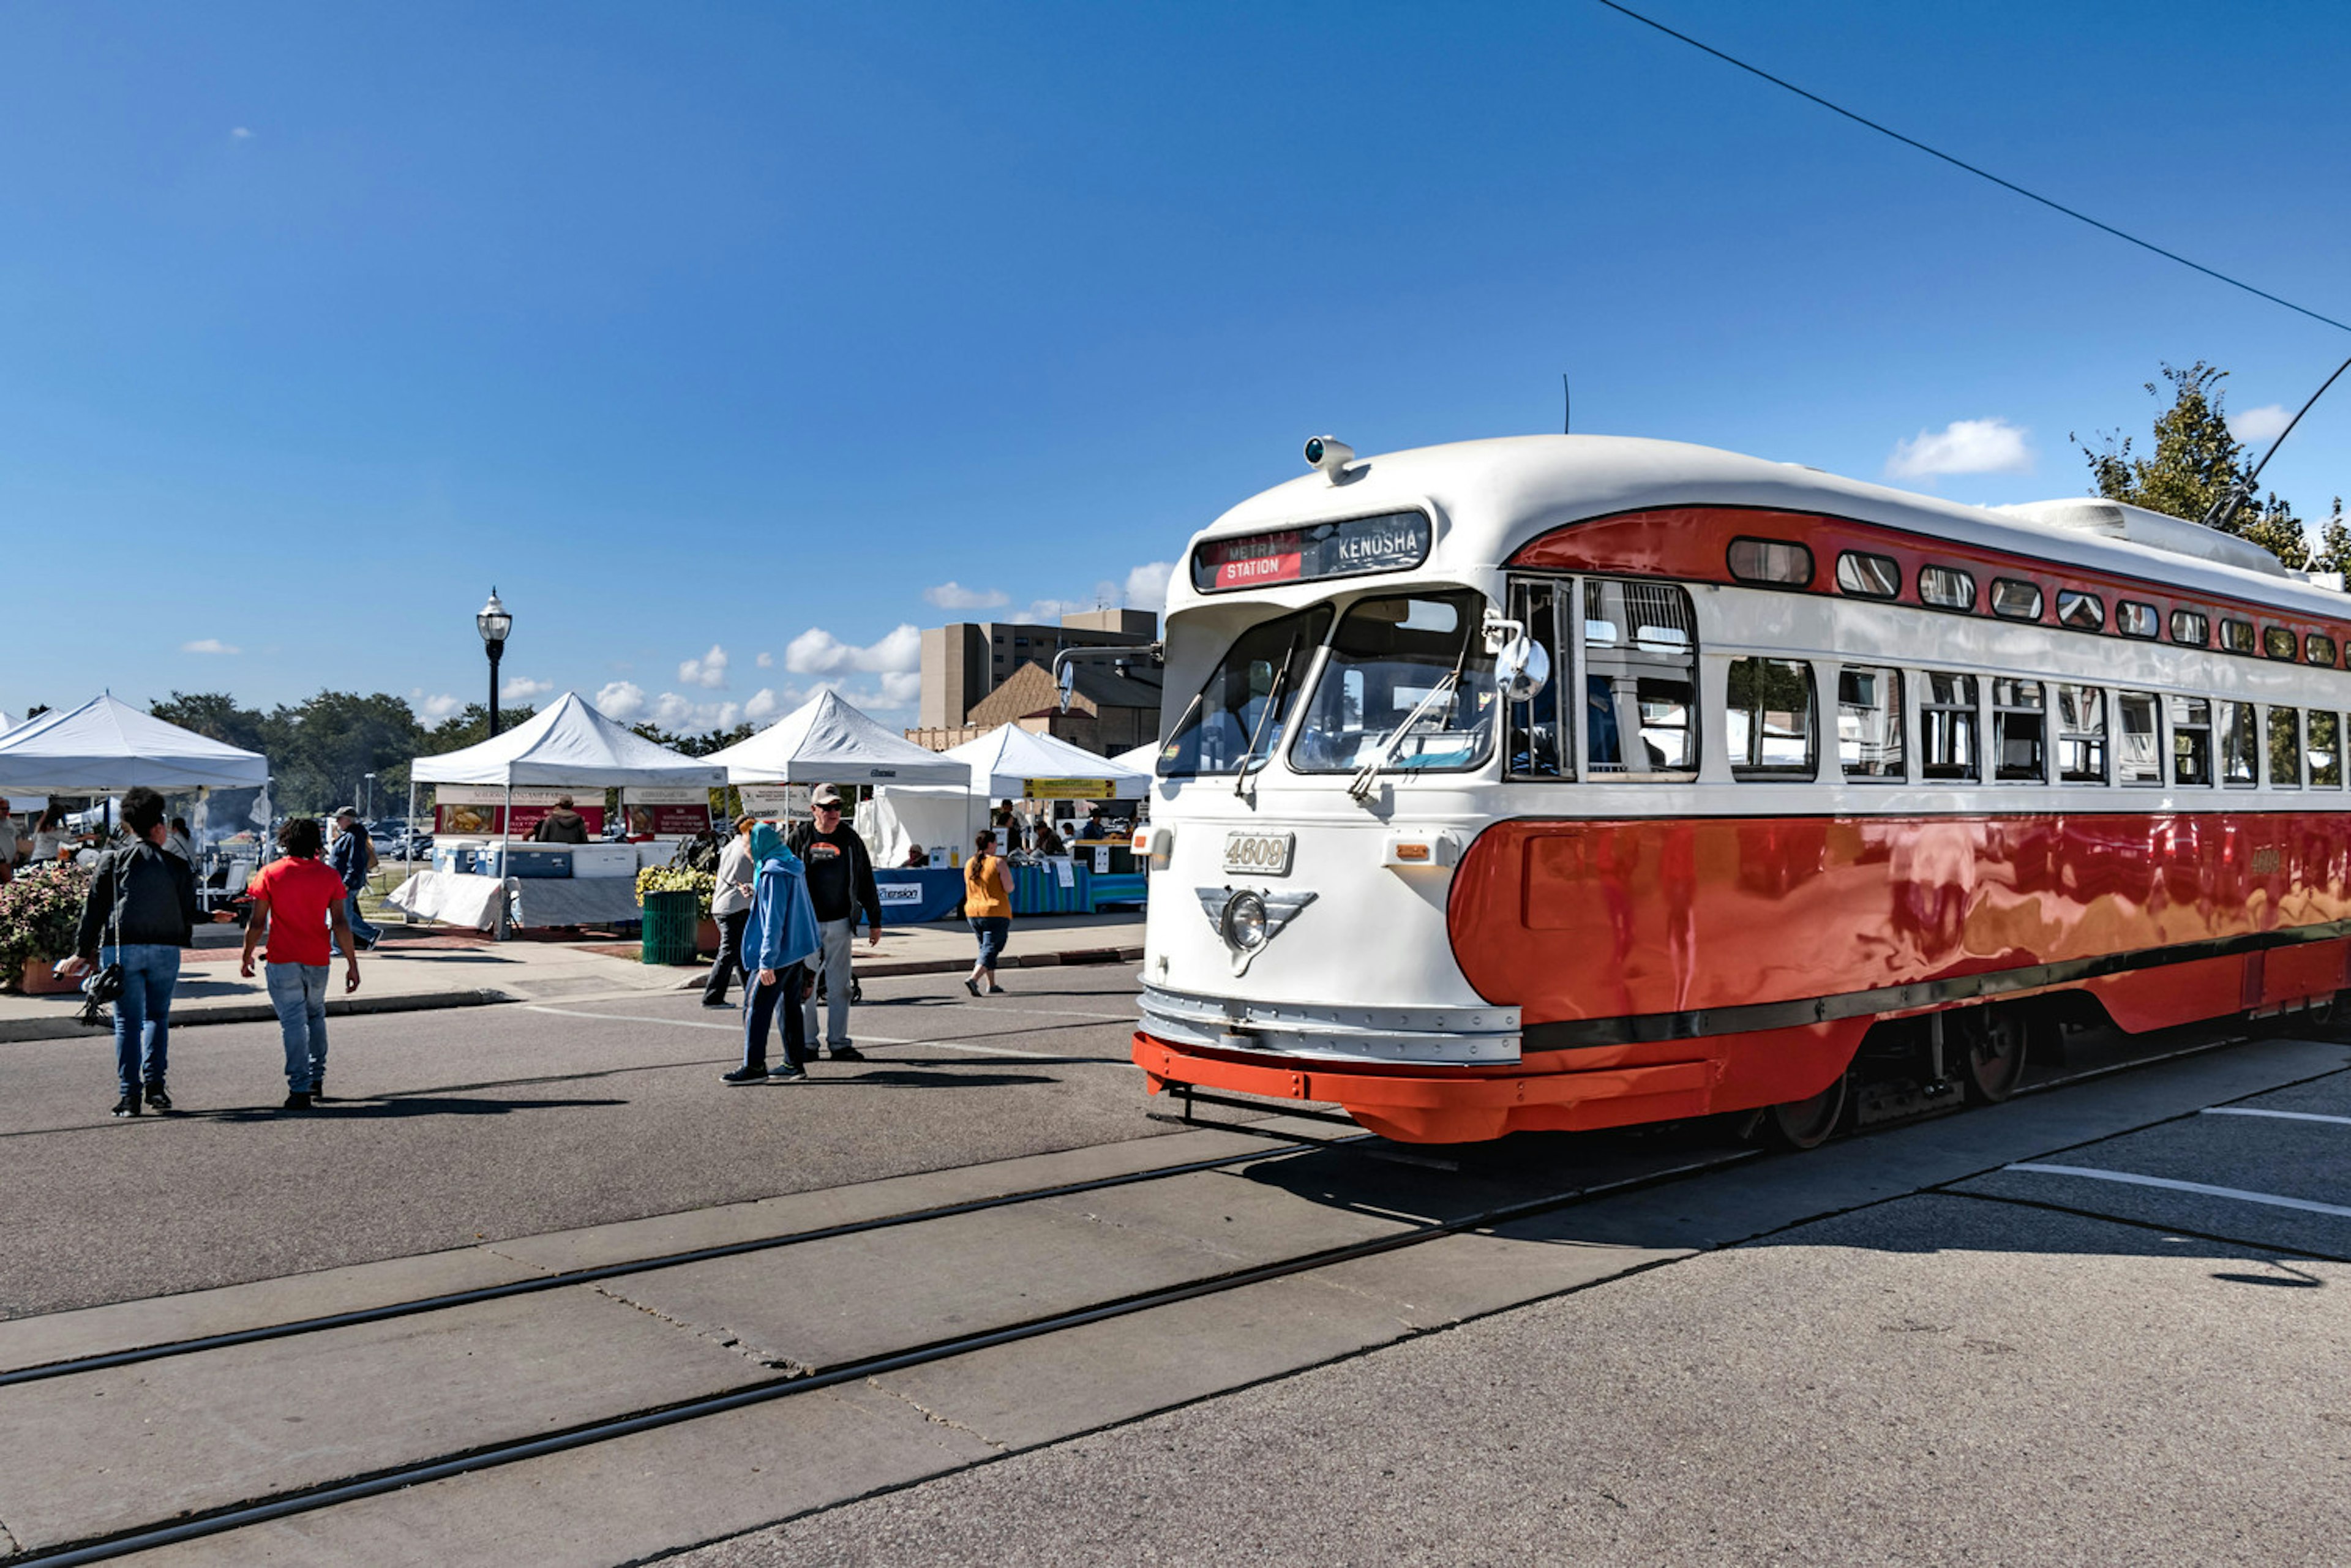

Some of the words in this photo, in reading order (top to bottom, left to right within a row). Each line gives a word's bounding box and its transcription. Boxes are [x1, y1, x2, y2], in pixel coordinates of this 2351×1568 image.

[1229, 542, 1277, 561] METRA
[1340, 529, 1417, 560] KENOSHA
[1227, 558, 1280, 579] STATION
[1226, 838, 1284, 866] 4609
[2251, 849, 2280, 875] 4609
